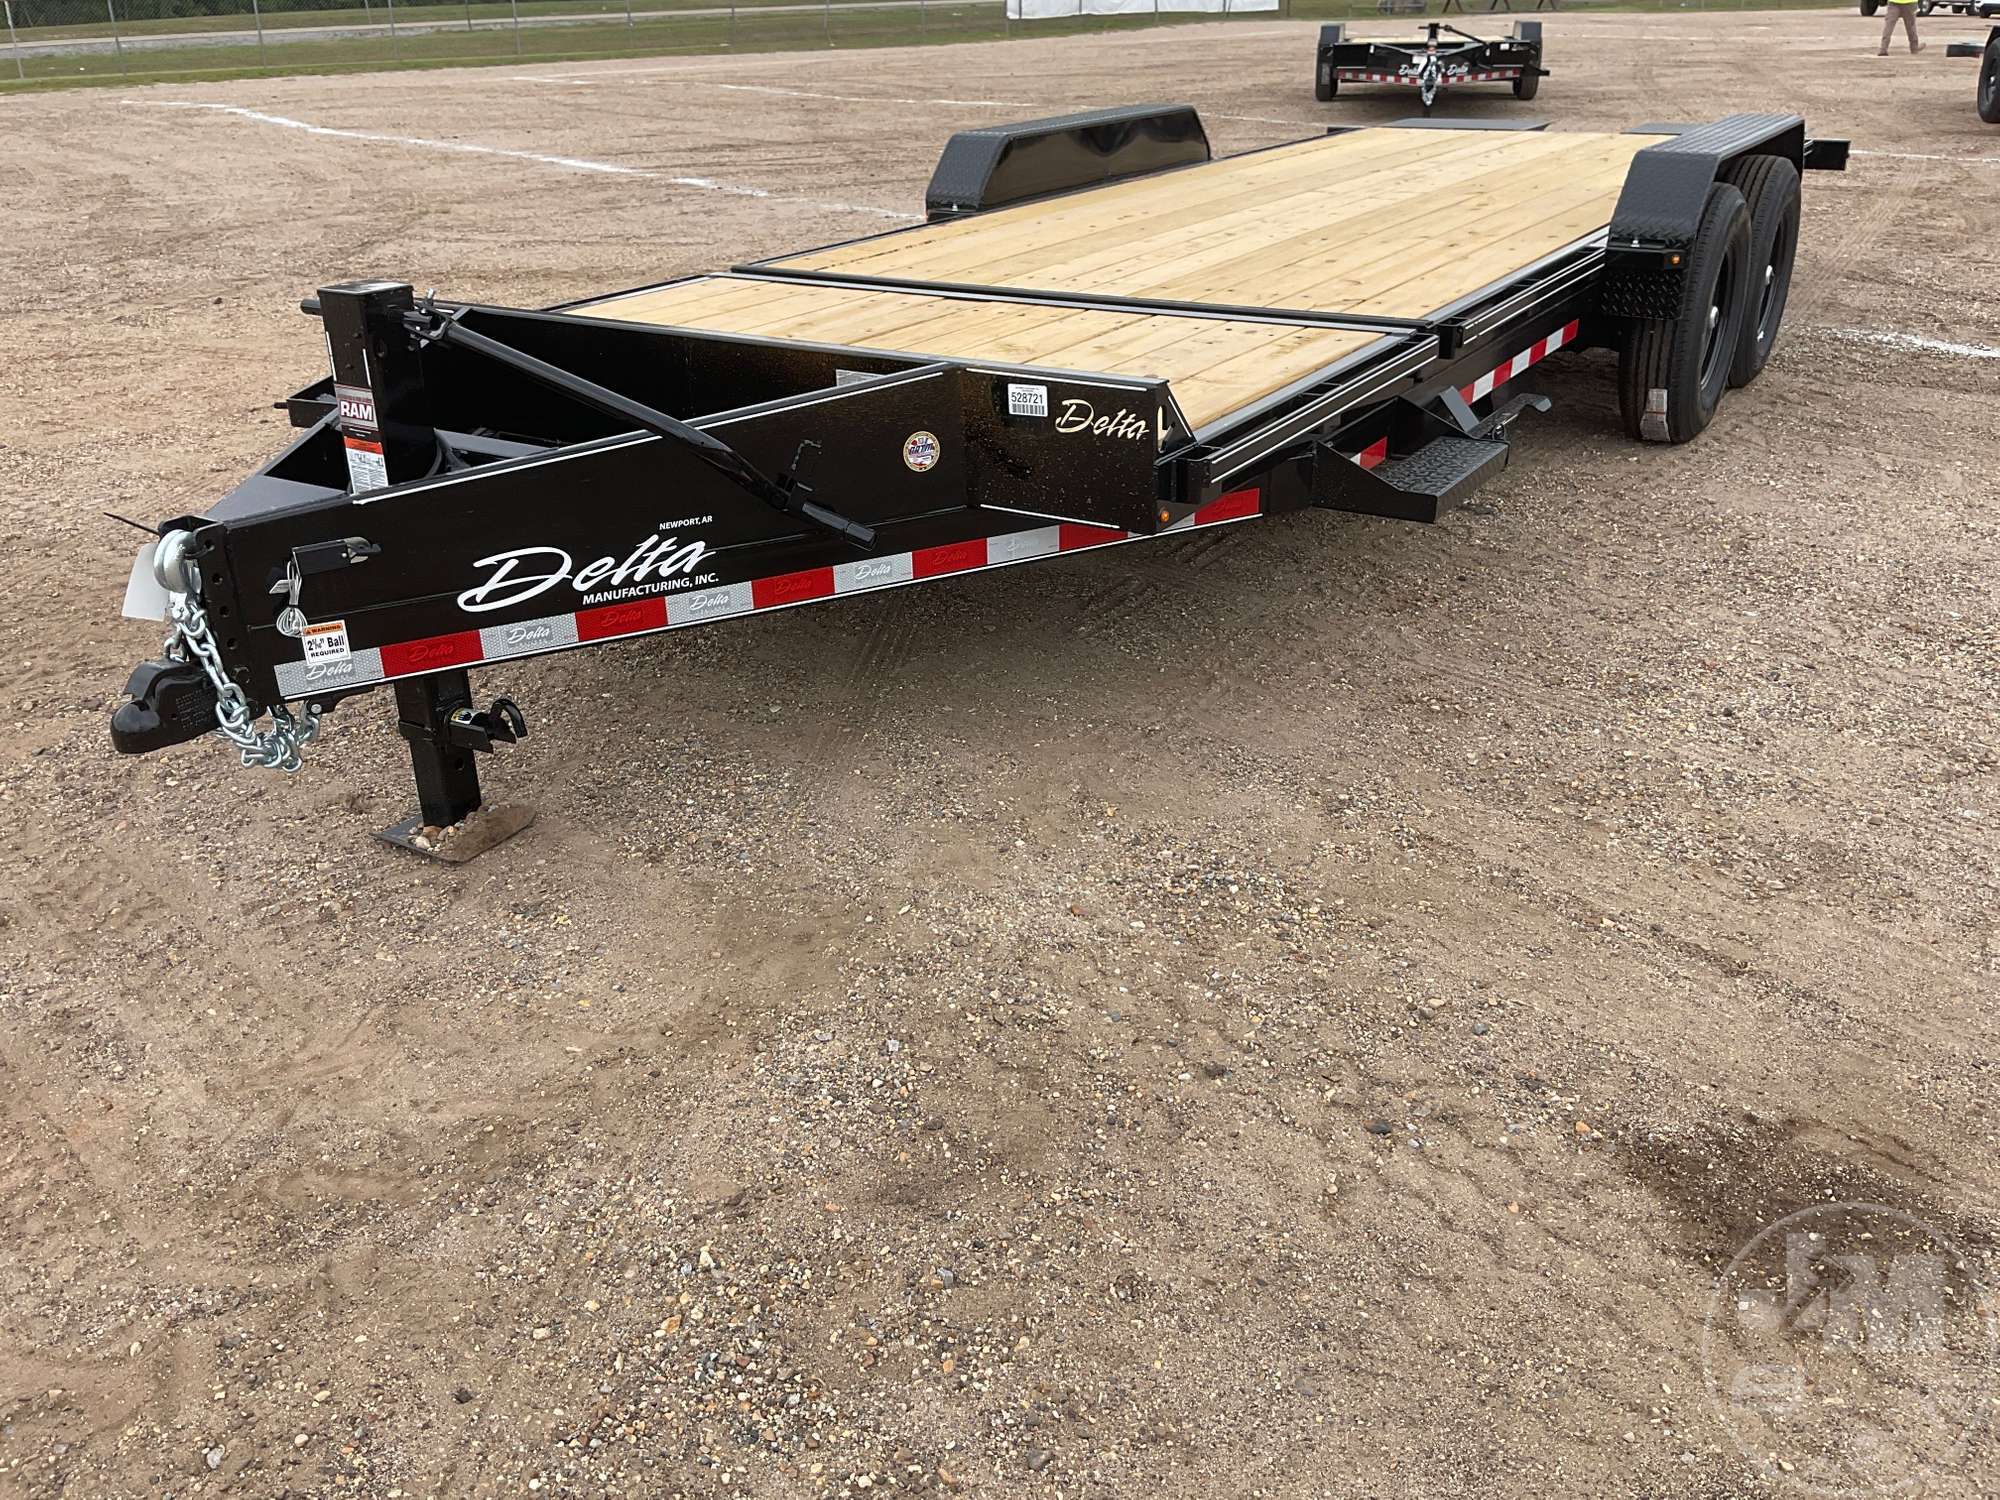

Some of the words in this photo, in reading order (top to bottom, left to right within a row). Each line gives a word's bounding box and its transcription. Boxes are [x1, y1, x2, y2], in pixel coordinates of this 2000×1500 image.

[1011, 391, 1043, 404] 528721
[340, 400, 374, 421] RAM
[1055, 399, 1149, 440] Delta
[659, 516, 701, 530] NEWPORT,
[701, 515, 713, 523] AR
[457, 534, 717, 613] Delta
[855, 563, 892, 579] Delta
[582, 579, 694, 605] MANUFACTURING,
[695, 572, 719, 585] INC.
[689, 593, 730, 611] Delta
[311, 624, 342, 633] WARNING
[507, 626, 551, 645] Delta
[327, 634, 345, 648] Ball
[310, 647, 345, 658] REQUIRED
[306, 661, 352, 680] Delta
